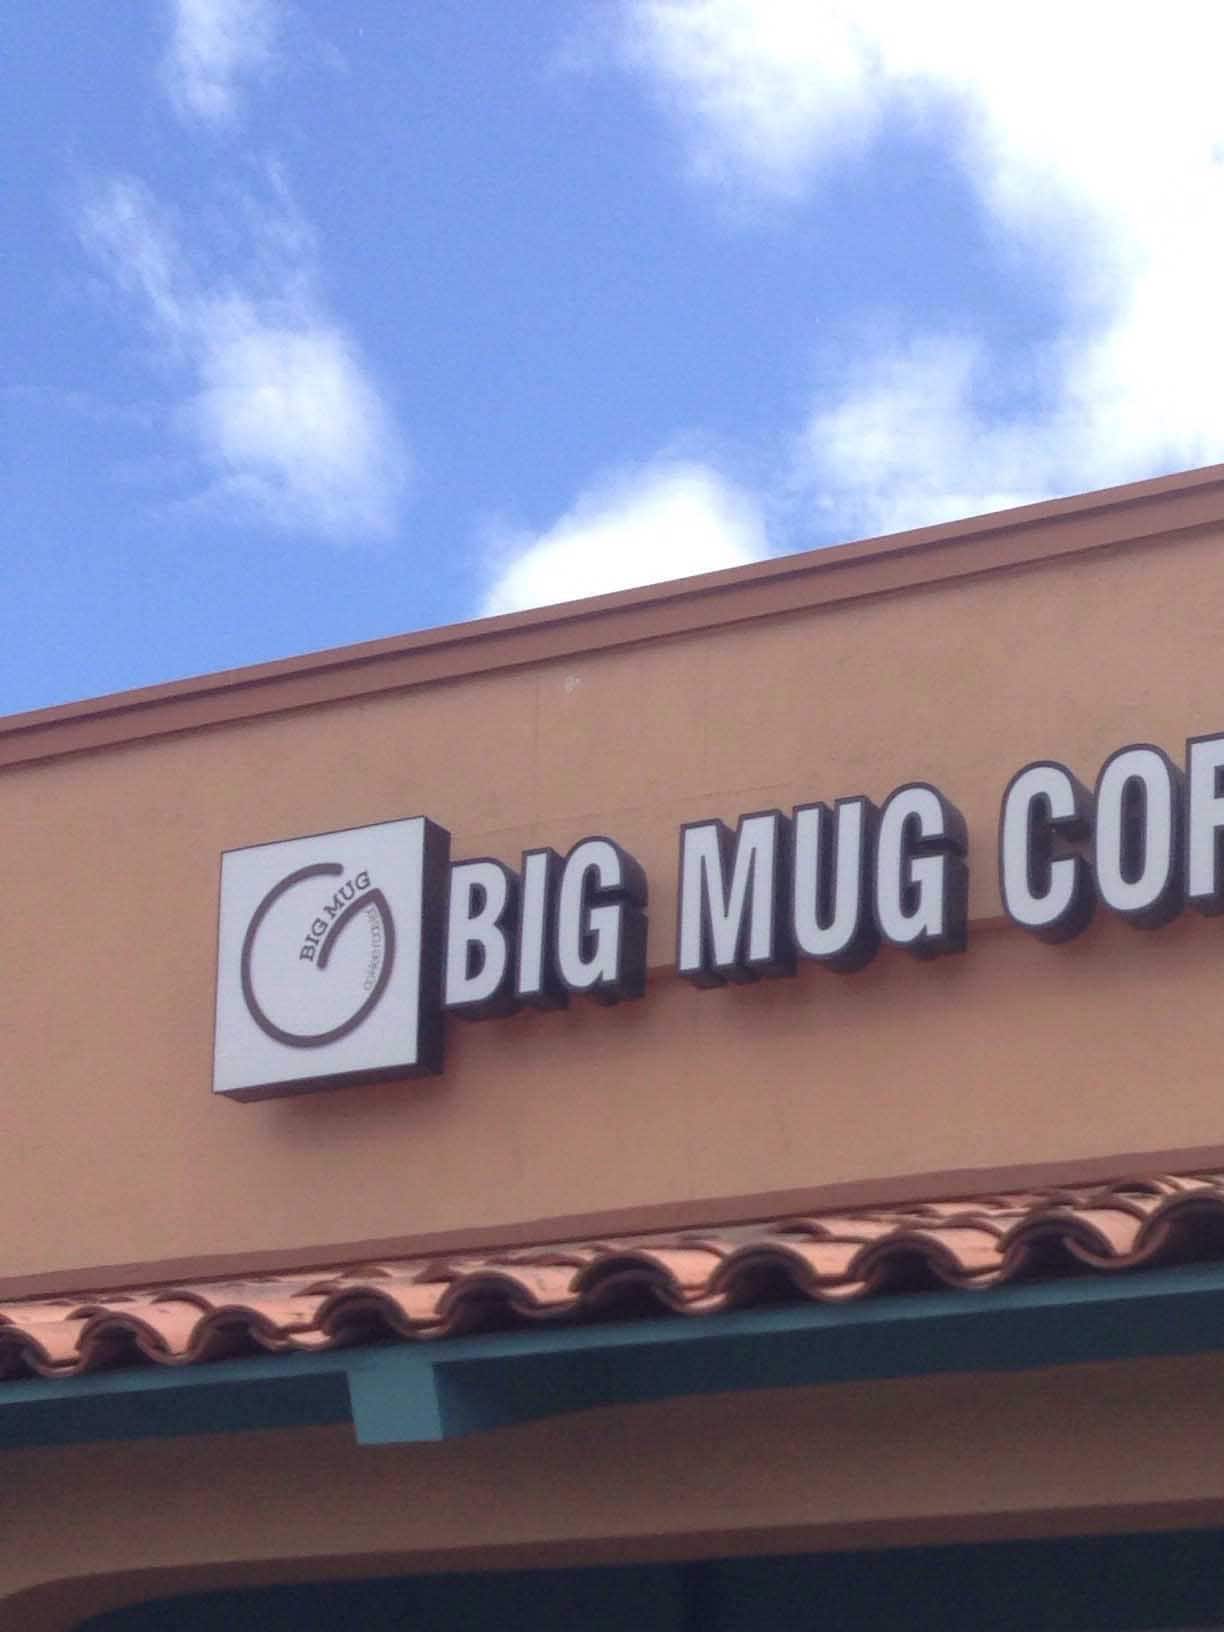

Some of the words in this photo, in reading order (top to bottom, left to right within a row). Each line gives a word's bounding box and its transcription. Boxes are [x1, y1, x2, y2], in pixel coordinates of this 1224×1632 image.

[300, 918, 328, 962] BIG
[323, 871, 371, 917] MUG
[444, 838, 622, 1005] BIG
[678, 786, 945, 971] MUG
